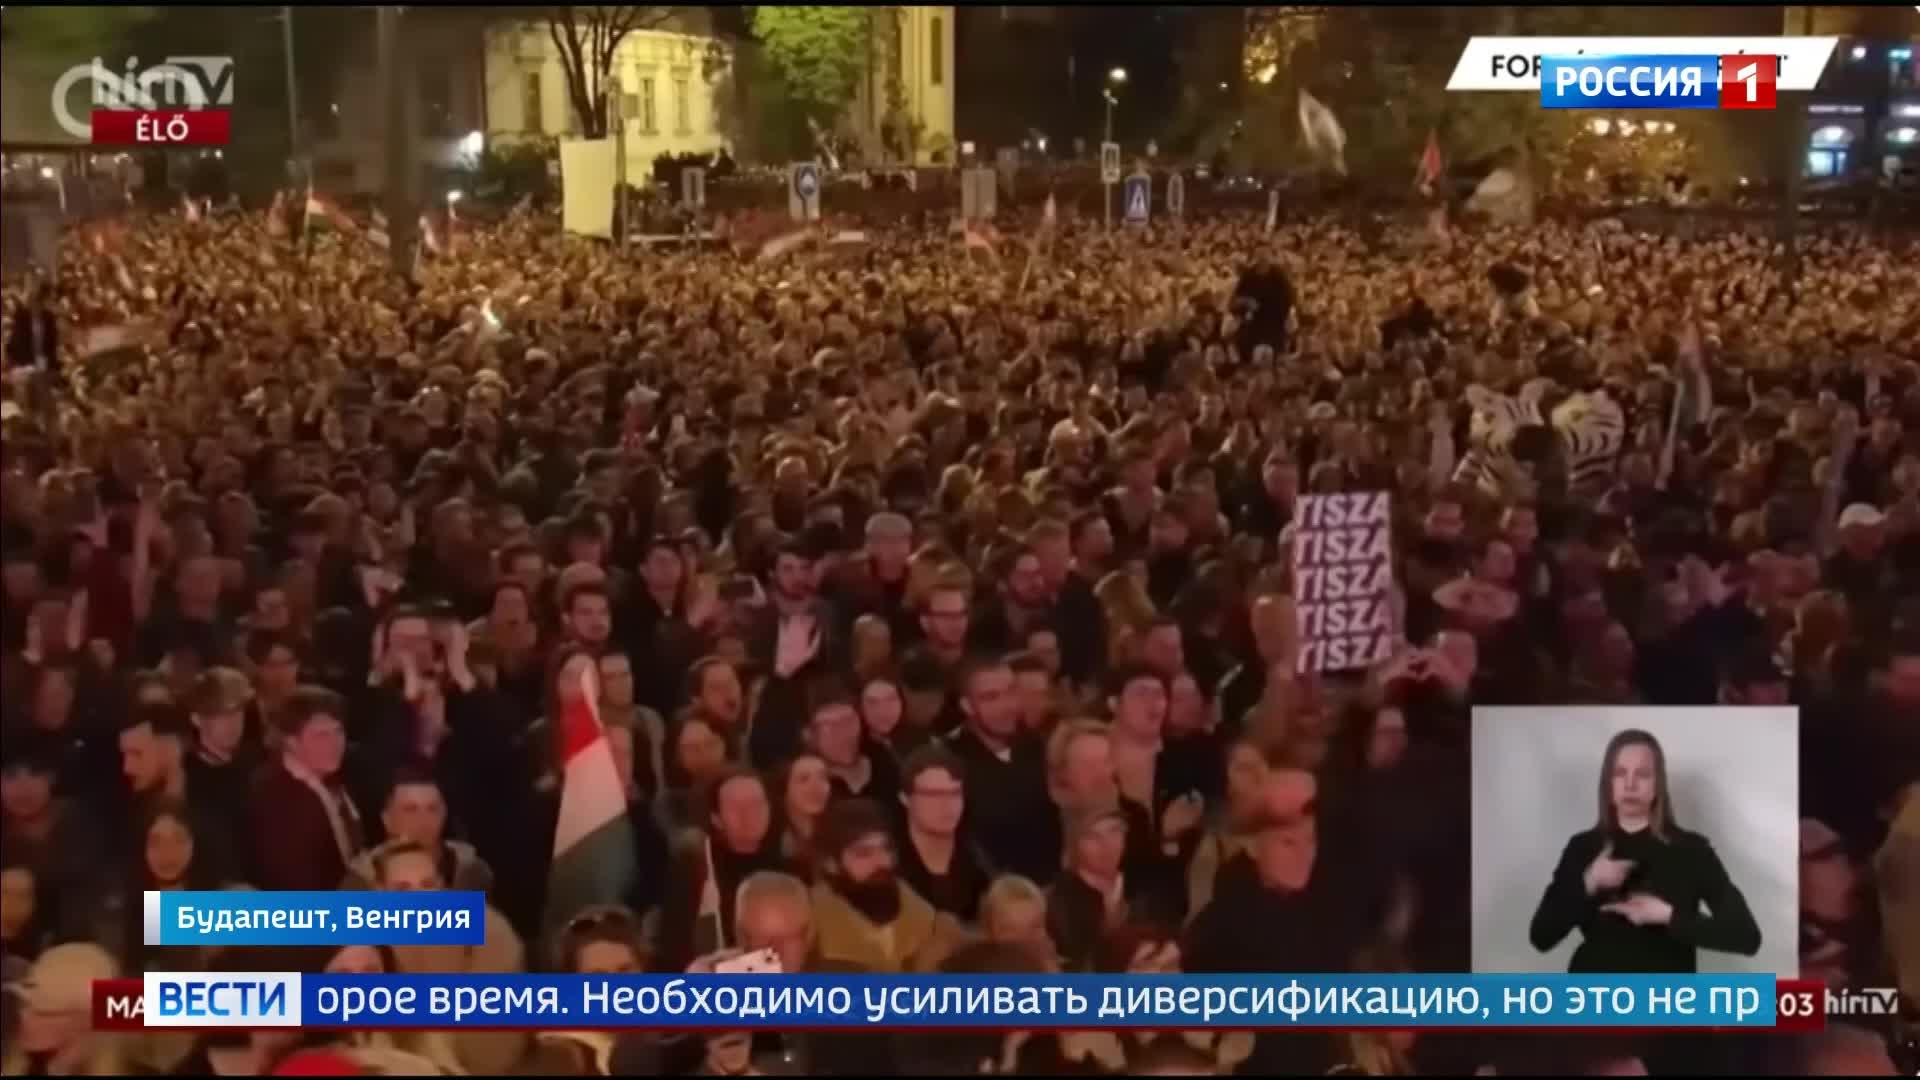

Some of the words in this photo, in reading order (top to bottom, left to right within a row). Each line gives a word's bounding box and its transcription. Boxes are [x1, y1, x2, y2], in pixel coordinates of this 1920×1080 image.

[1295, 492, 1391, 526] TISZA
[1296, 527, 1391, 565] TISZA
[1296, 564, 1391, 601] TISZA
[1297, 600, 1391, 637] TISZA
[1297, 635, 1391, 673] TISZA
